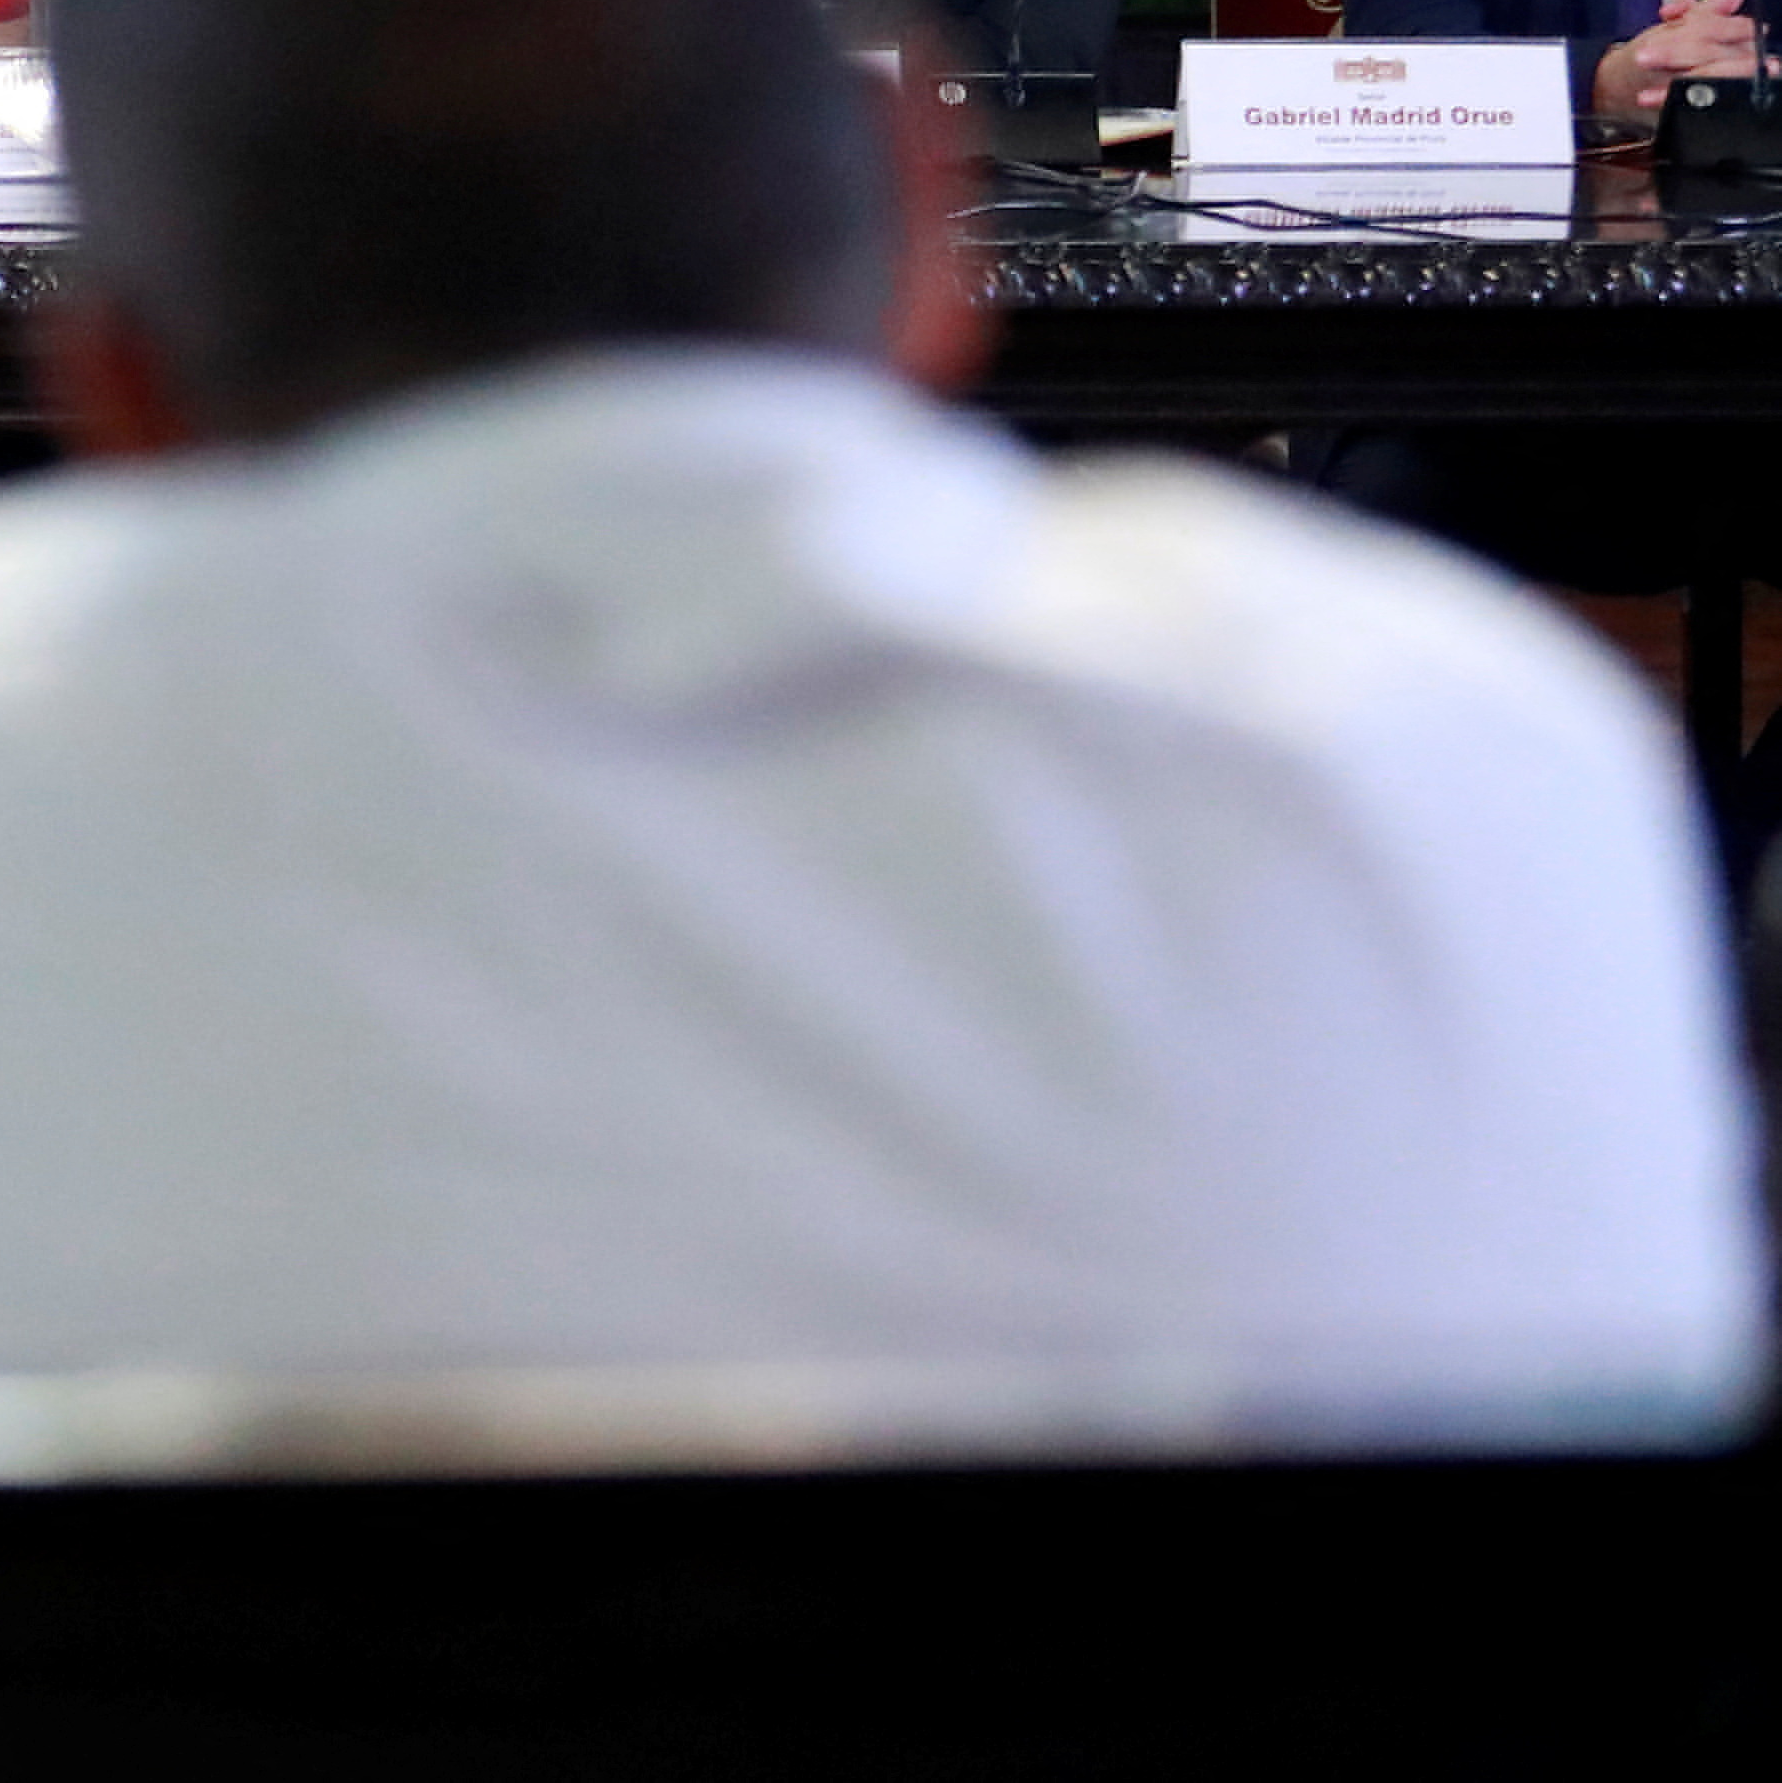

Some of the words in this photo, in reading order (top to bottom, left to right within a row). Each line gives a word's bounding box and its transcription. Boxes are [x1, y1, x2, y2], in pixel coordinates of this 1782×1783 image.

[1244, 106, 1340, 126] Gabriel
[1351, 106, 1442, 126] Madrid
[1450, 105, 1515, 126] Orue
